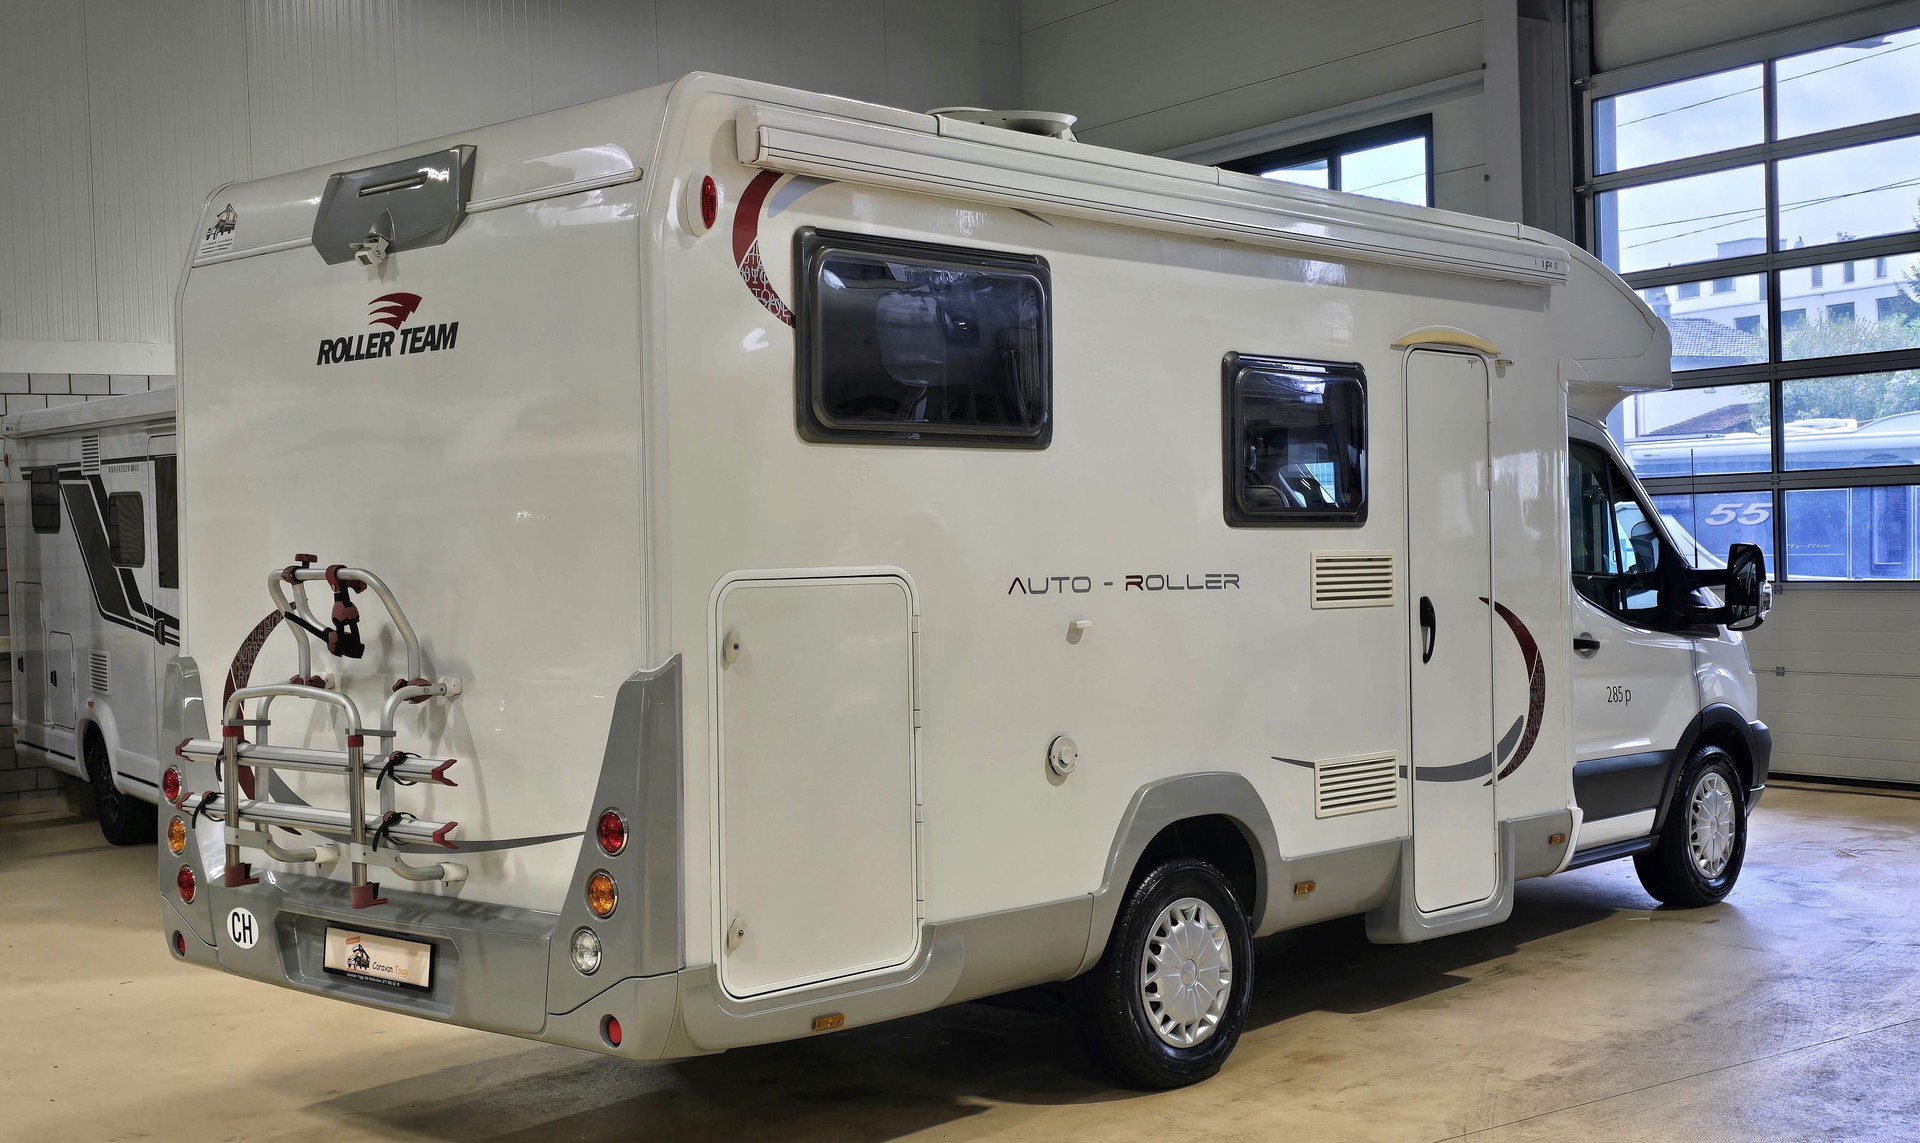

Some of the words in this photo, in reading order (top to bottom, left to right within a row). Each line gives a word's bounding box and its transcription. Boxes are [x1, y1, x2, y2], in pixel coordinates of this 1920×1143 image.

[317, 331, 395, 366] ROLLER
[400, 322, 459, 355] TEAM
[1704, 502, 1772, 526] 55
[1008, 576, 1091, 595] AUTO
[1125, 574, 1240, 591] ROLLER
[232, 911, 252, 944] CH
[372, 962, 393, 973] Caravan
